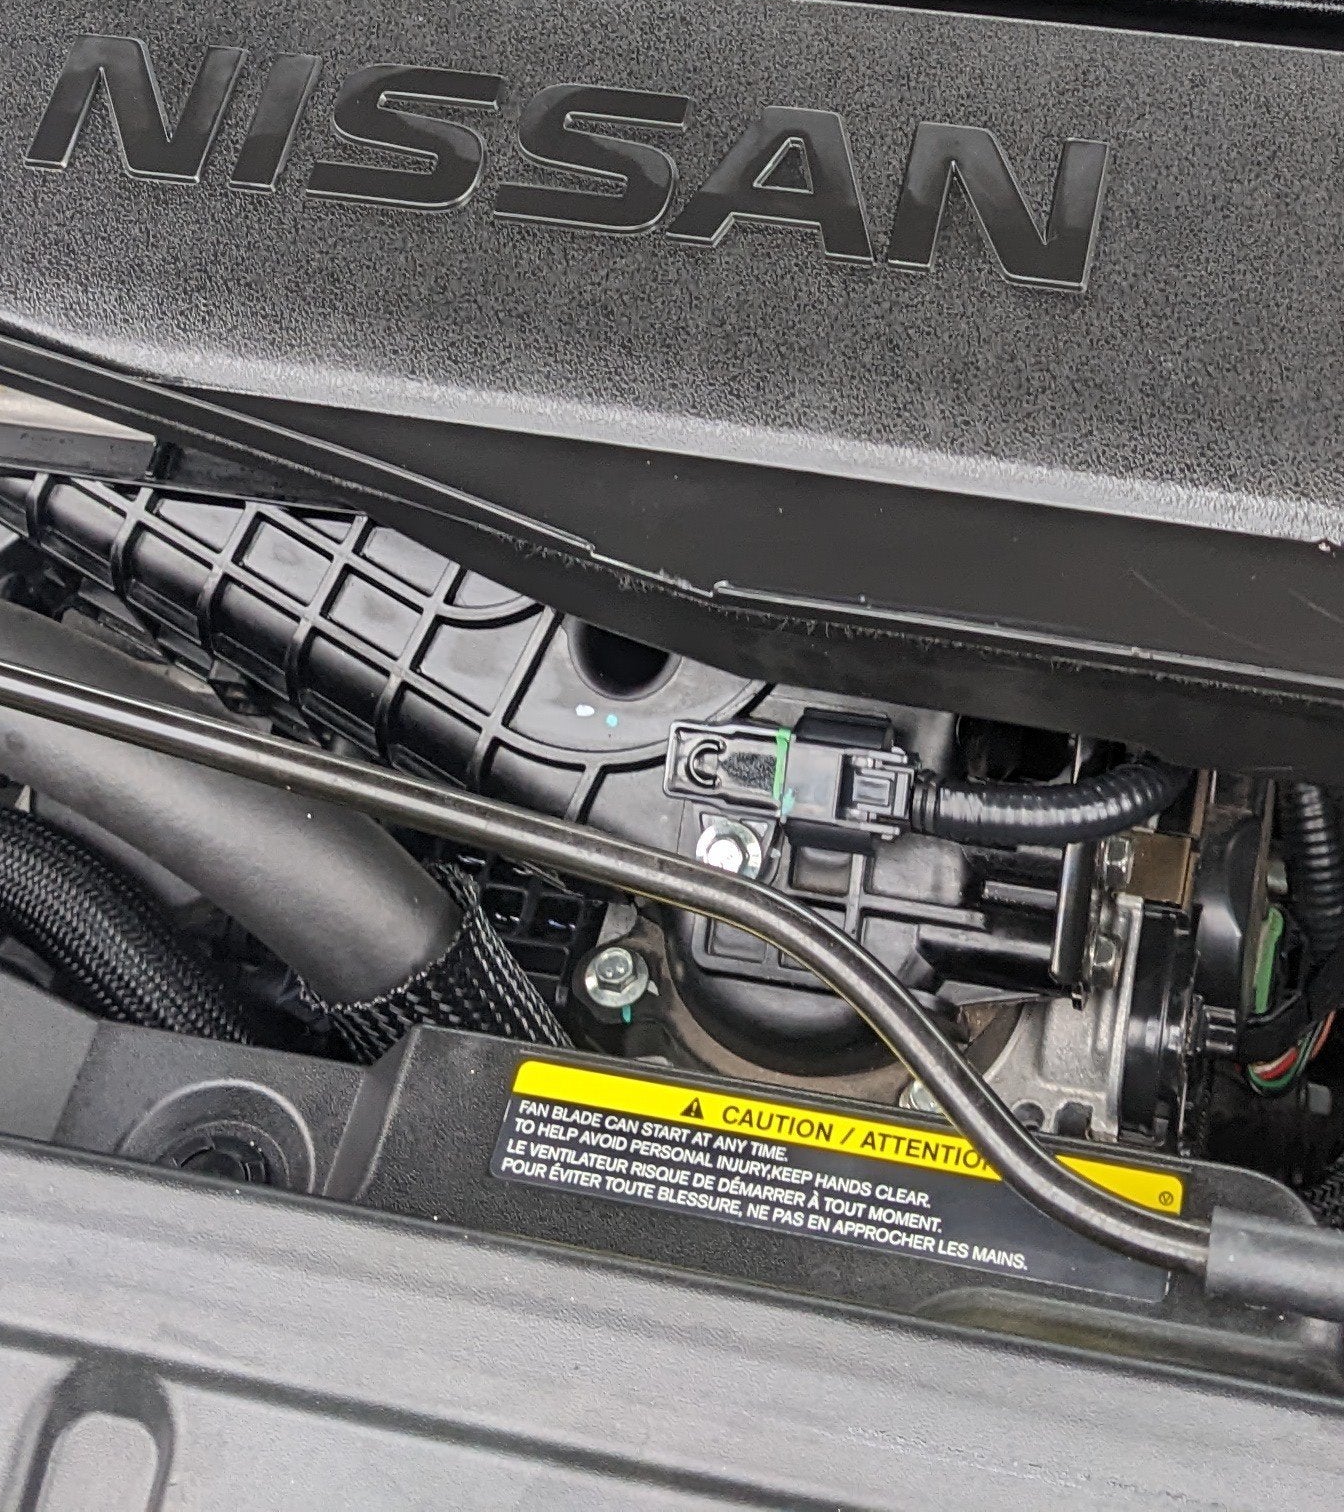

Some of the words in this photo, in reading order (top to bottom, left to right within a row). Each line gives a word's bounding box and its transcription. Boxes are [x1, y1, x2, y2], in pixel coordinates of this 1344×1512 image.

[23, 33, 1110, 292] NISSAN
[515, 1118, 536, 1134] TO
[537, 1121, 579, 1141] HELP
[579, 1130, 628, 1151] AVOID
[629, 1138, 714, 1168] PERSONAL
[815, 1173, 872, 1197] HANDS
[875, 1185, 931, 1209] CLEAR.
[518, 1099, 550, 1118] FAN
[551, 1105, 603, 1127] BLADE
[605, 1115, 639, 1134] CAN
[641, 1122, 690, 1143] START
[692, 1131, 713, 1148] AT
[713, 1136, 748, 1155] ANY
[750, 1142, 788, 1163] TIME.
[722, 1105, 834, 1142] CAUTION
[501, 1157, 547, 1180] POUR
[548, 1162, 603, 1189] ÉVITER
[605, 1178, 655, 1200] TOUTE
[657, 1186, 743, 1218] BLESSURE,
[746, 1202, 771, 1221] NE
[772, 1207, 805, 1227] PAS
[806, 1214, 831, 1233] EN
[832, 1219, 936, 1253] APPROCHER
[937, 1239, 969, 1260] LES
[972, 1246, 1029, 1271] MAINS.
[507, 1139, 527, 1155] LE
[529, 1141, 628, 1174] VENTILATEUR
[630, 1161, 690, 1187] RISQUE
[692, 1172, 715, 1190] DE
[717, 1175, 806, 1207] DÉMARRER
[807, 1192, 820, 1210] À
[823, 1197, 867, 1219] TOUT
[868, 1206, 943, 1233] MOMENT.
